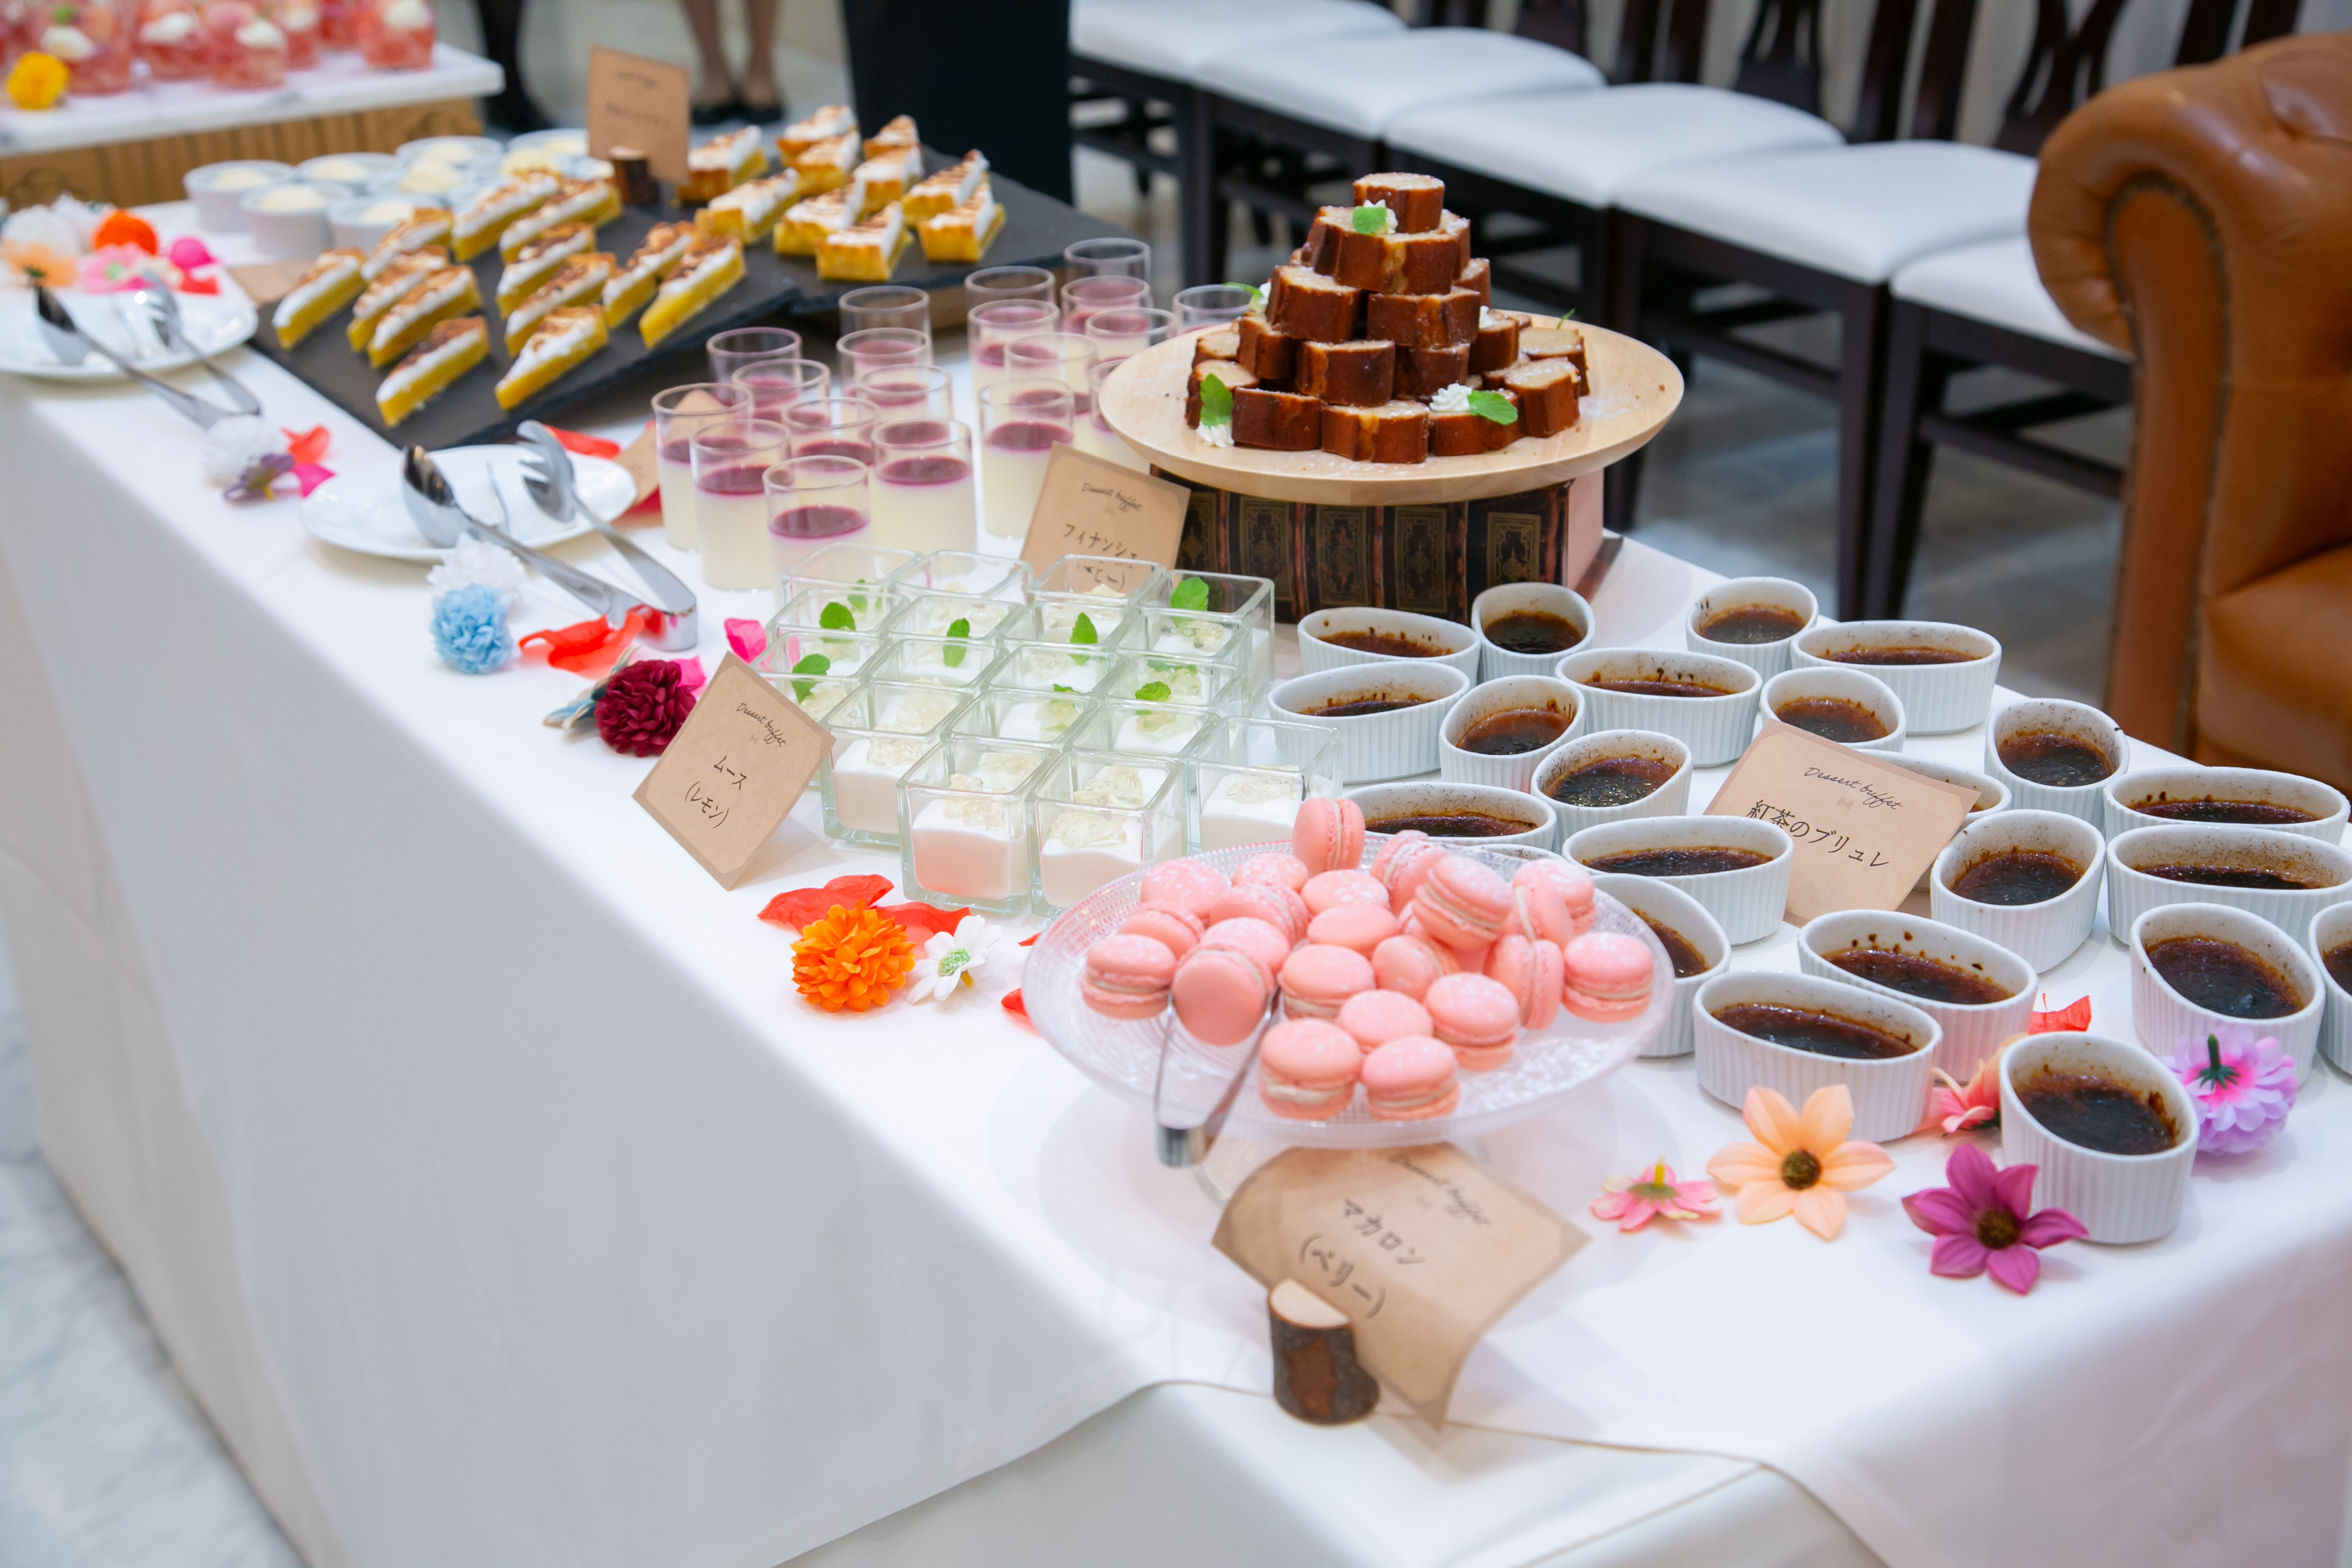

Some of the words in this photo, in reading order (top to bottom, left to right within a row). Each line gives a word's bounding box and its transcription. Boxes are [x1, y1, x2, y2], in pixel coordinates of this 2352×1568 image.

[736, 702, 768, 724] Dessert
[763, 719, 787, 747] buffet
[713, 755, 747, 791] ムース
[1803, 767, 1863, 789] Dessert
[1859, 783, 1904, 810] buffet
[684, 780, 730, 829] (レモン)
[1745, 799, 1890, 867] 紅茶のブリュレ
[1343, 1197, 1427, 1264] マカロン
